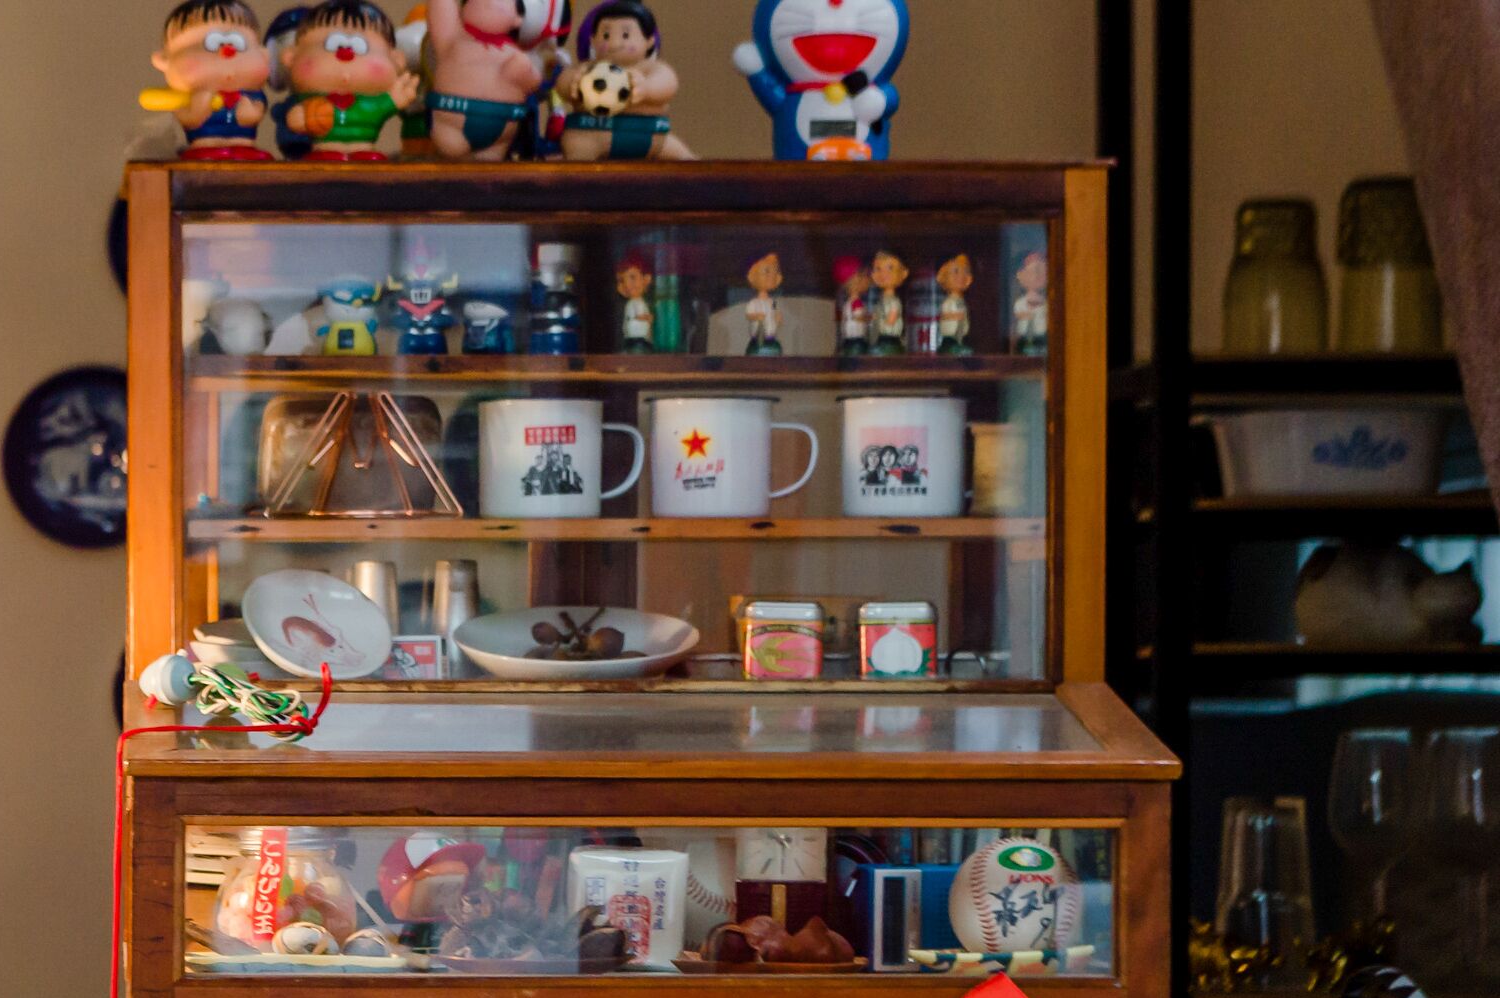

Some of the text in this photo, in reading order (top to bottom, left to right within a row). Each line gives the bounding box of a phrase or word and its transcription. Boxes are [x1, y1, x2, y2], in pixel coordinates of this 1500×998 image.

[438, 96, 469, 111] 2011
[1008, 873, 1054, 885] LIONS
[253, 839, 282, 935] こんぴら玉
